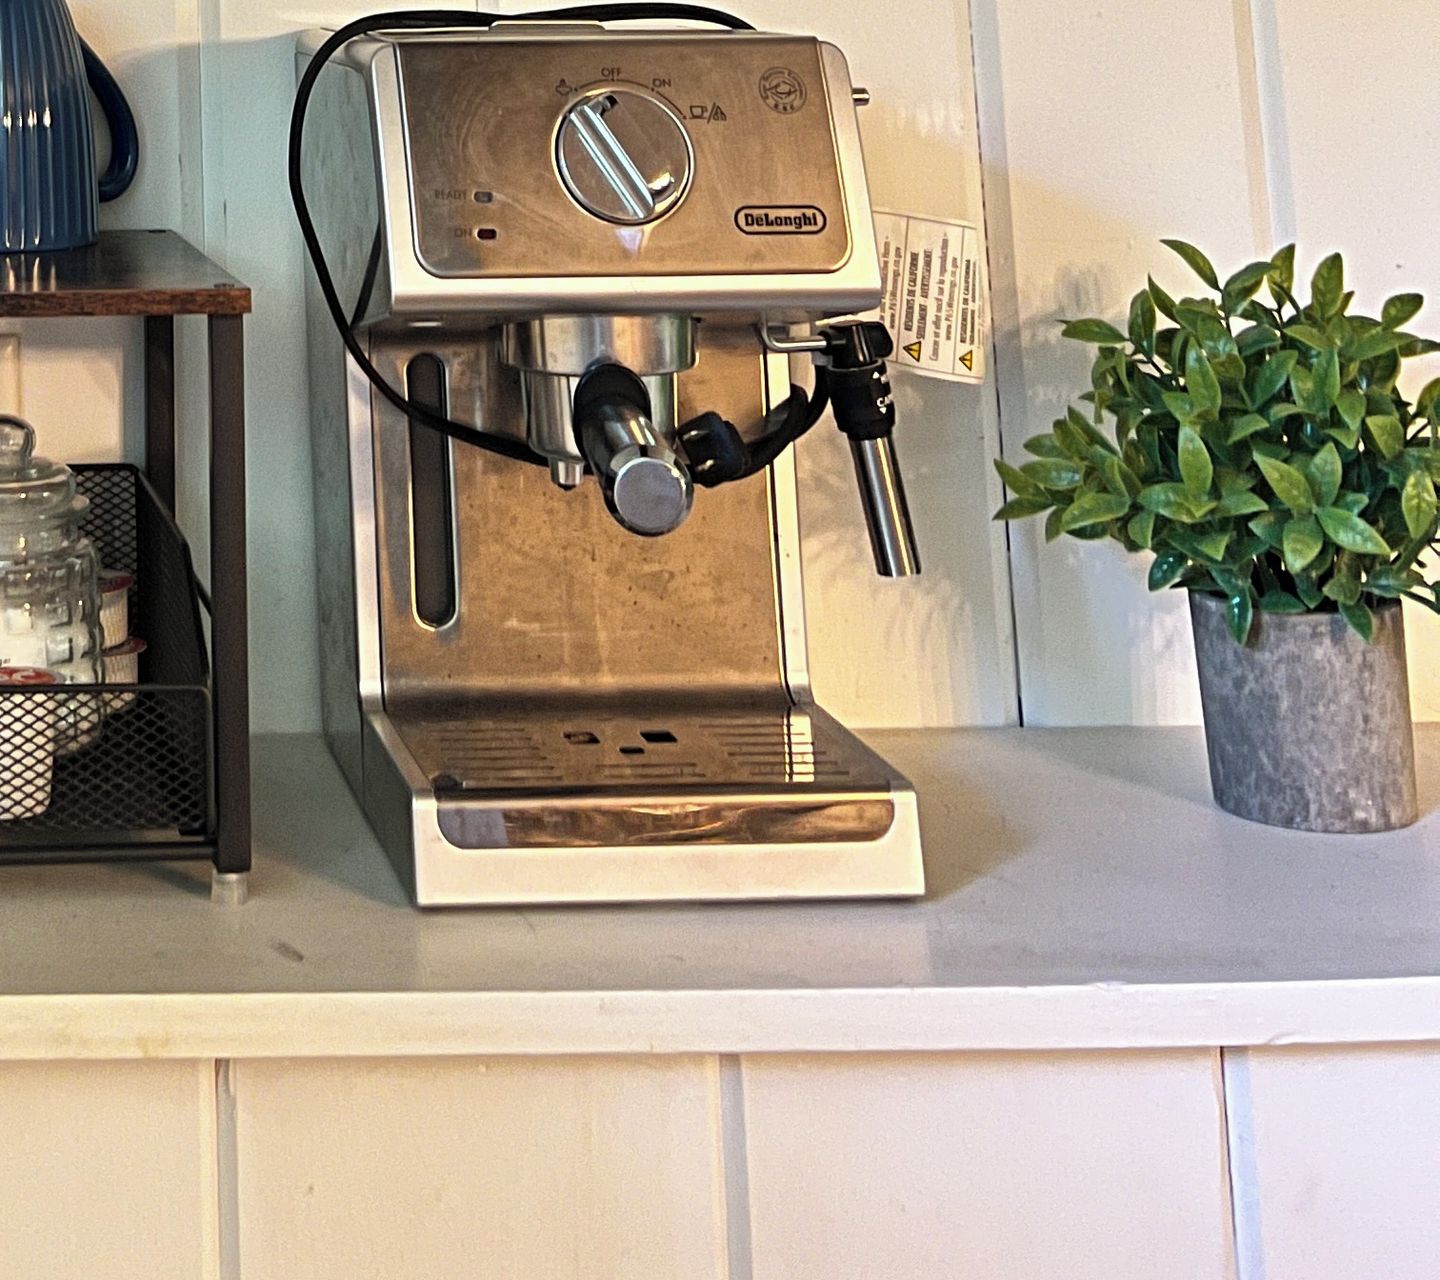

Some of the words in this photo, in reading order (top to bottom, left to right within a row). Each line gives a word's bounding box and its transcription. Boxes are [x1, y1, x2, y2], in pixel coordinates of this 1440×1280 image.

[601, 67, 622, 78] OFF
[652, 78, 672, 88] ON
[434, 189, 468, 200] READY
[454, 227, 472, 238] ON
